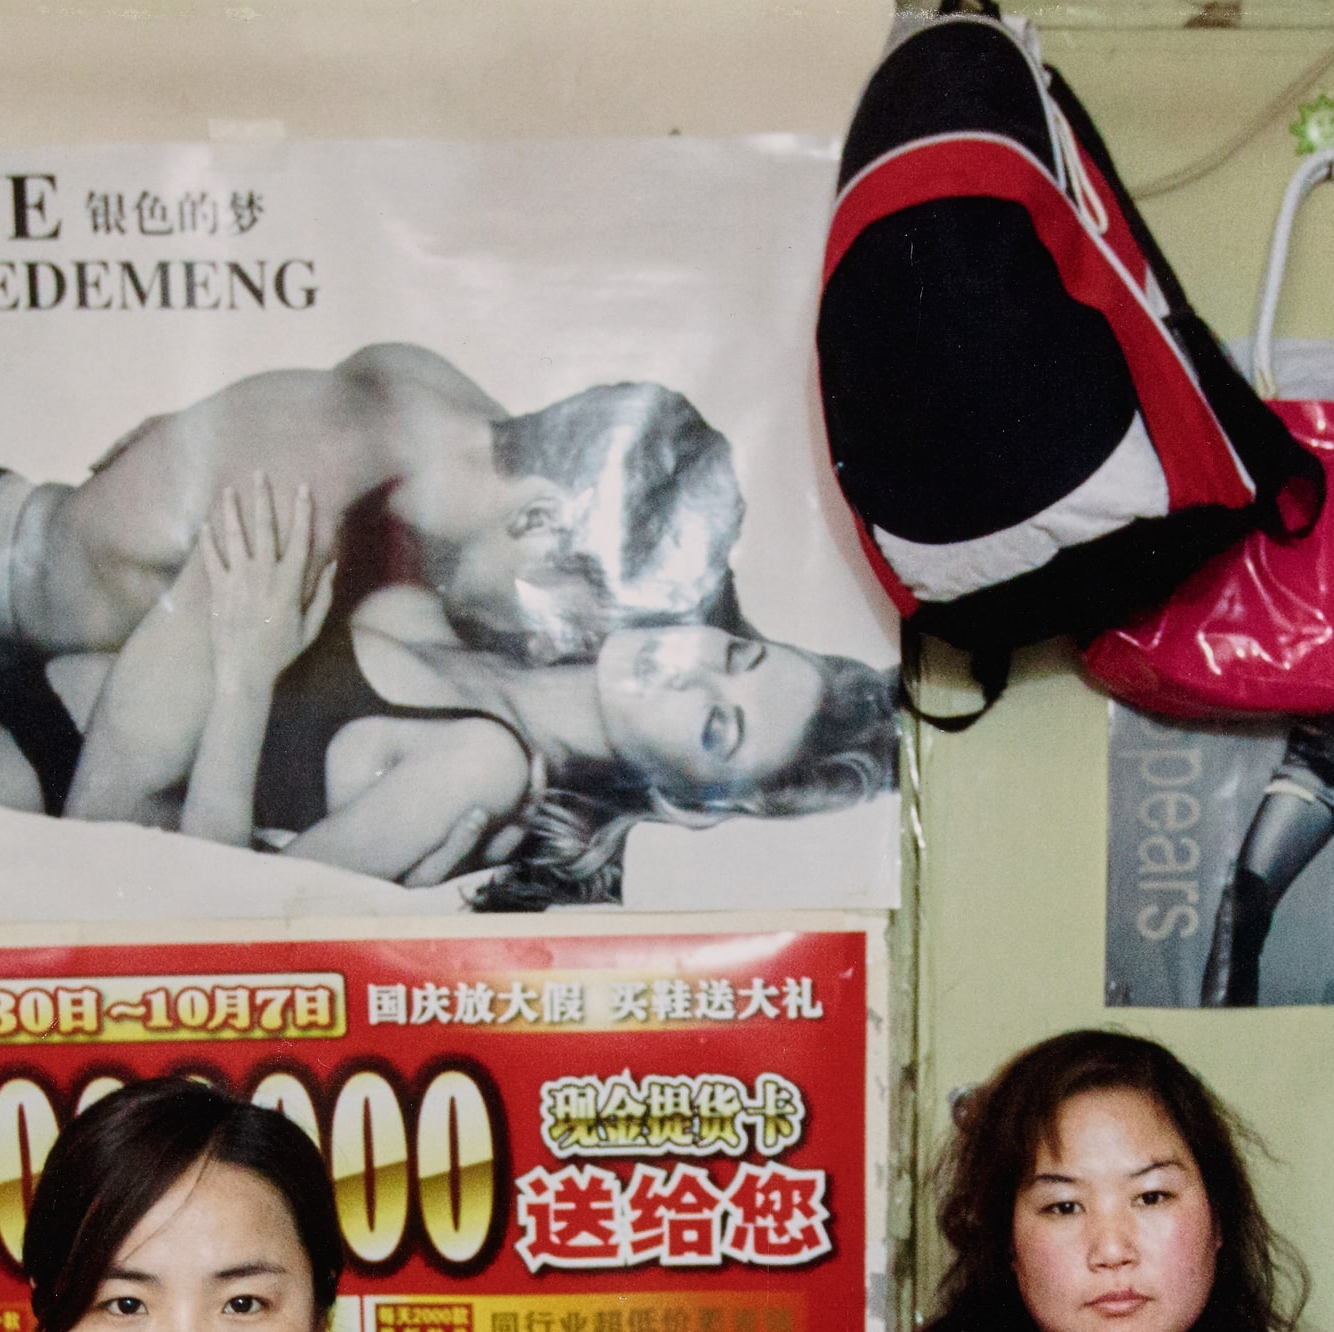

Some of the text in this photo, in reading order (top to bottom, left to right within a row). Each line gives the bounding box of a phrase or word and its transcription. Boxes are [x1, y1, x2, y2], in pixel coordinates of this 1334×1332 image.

[86, 190, 265, 236] 银色的梦
[1117, 721, 1203, 942] pears
[367, 976, 824, 1026] 国庆放大假 买鞋送大礼
[541, 1068, 805, 1157] 现金提货卡
[515, 1161, 831, 1273] 送给您
